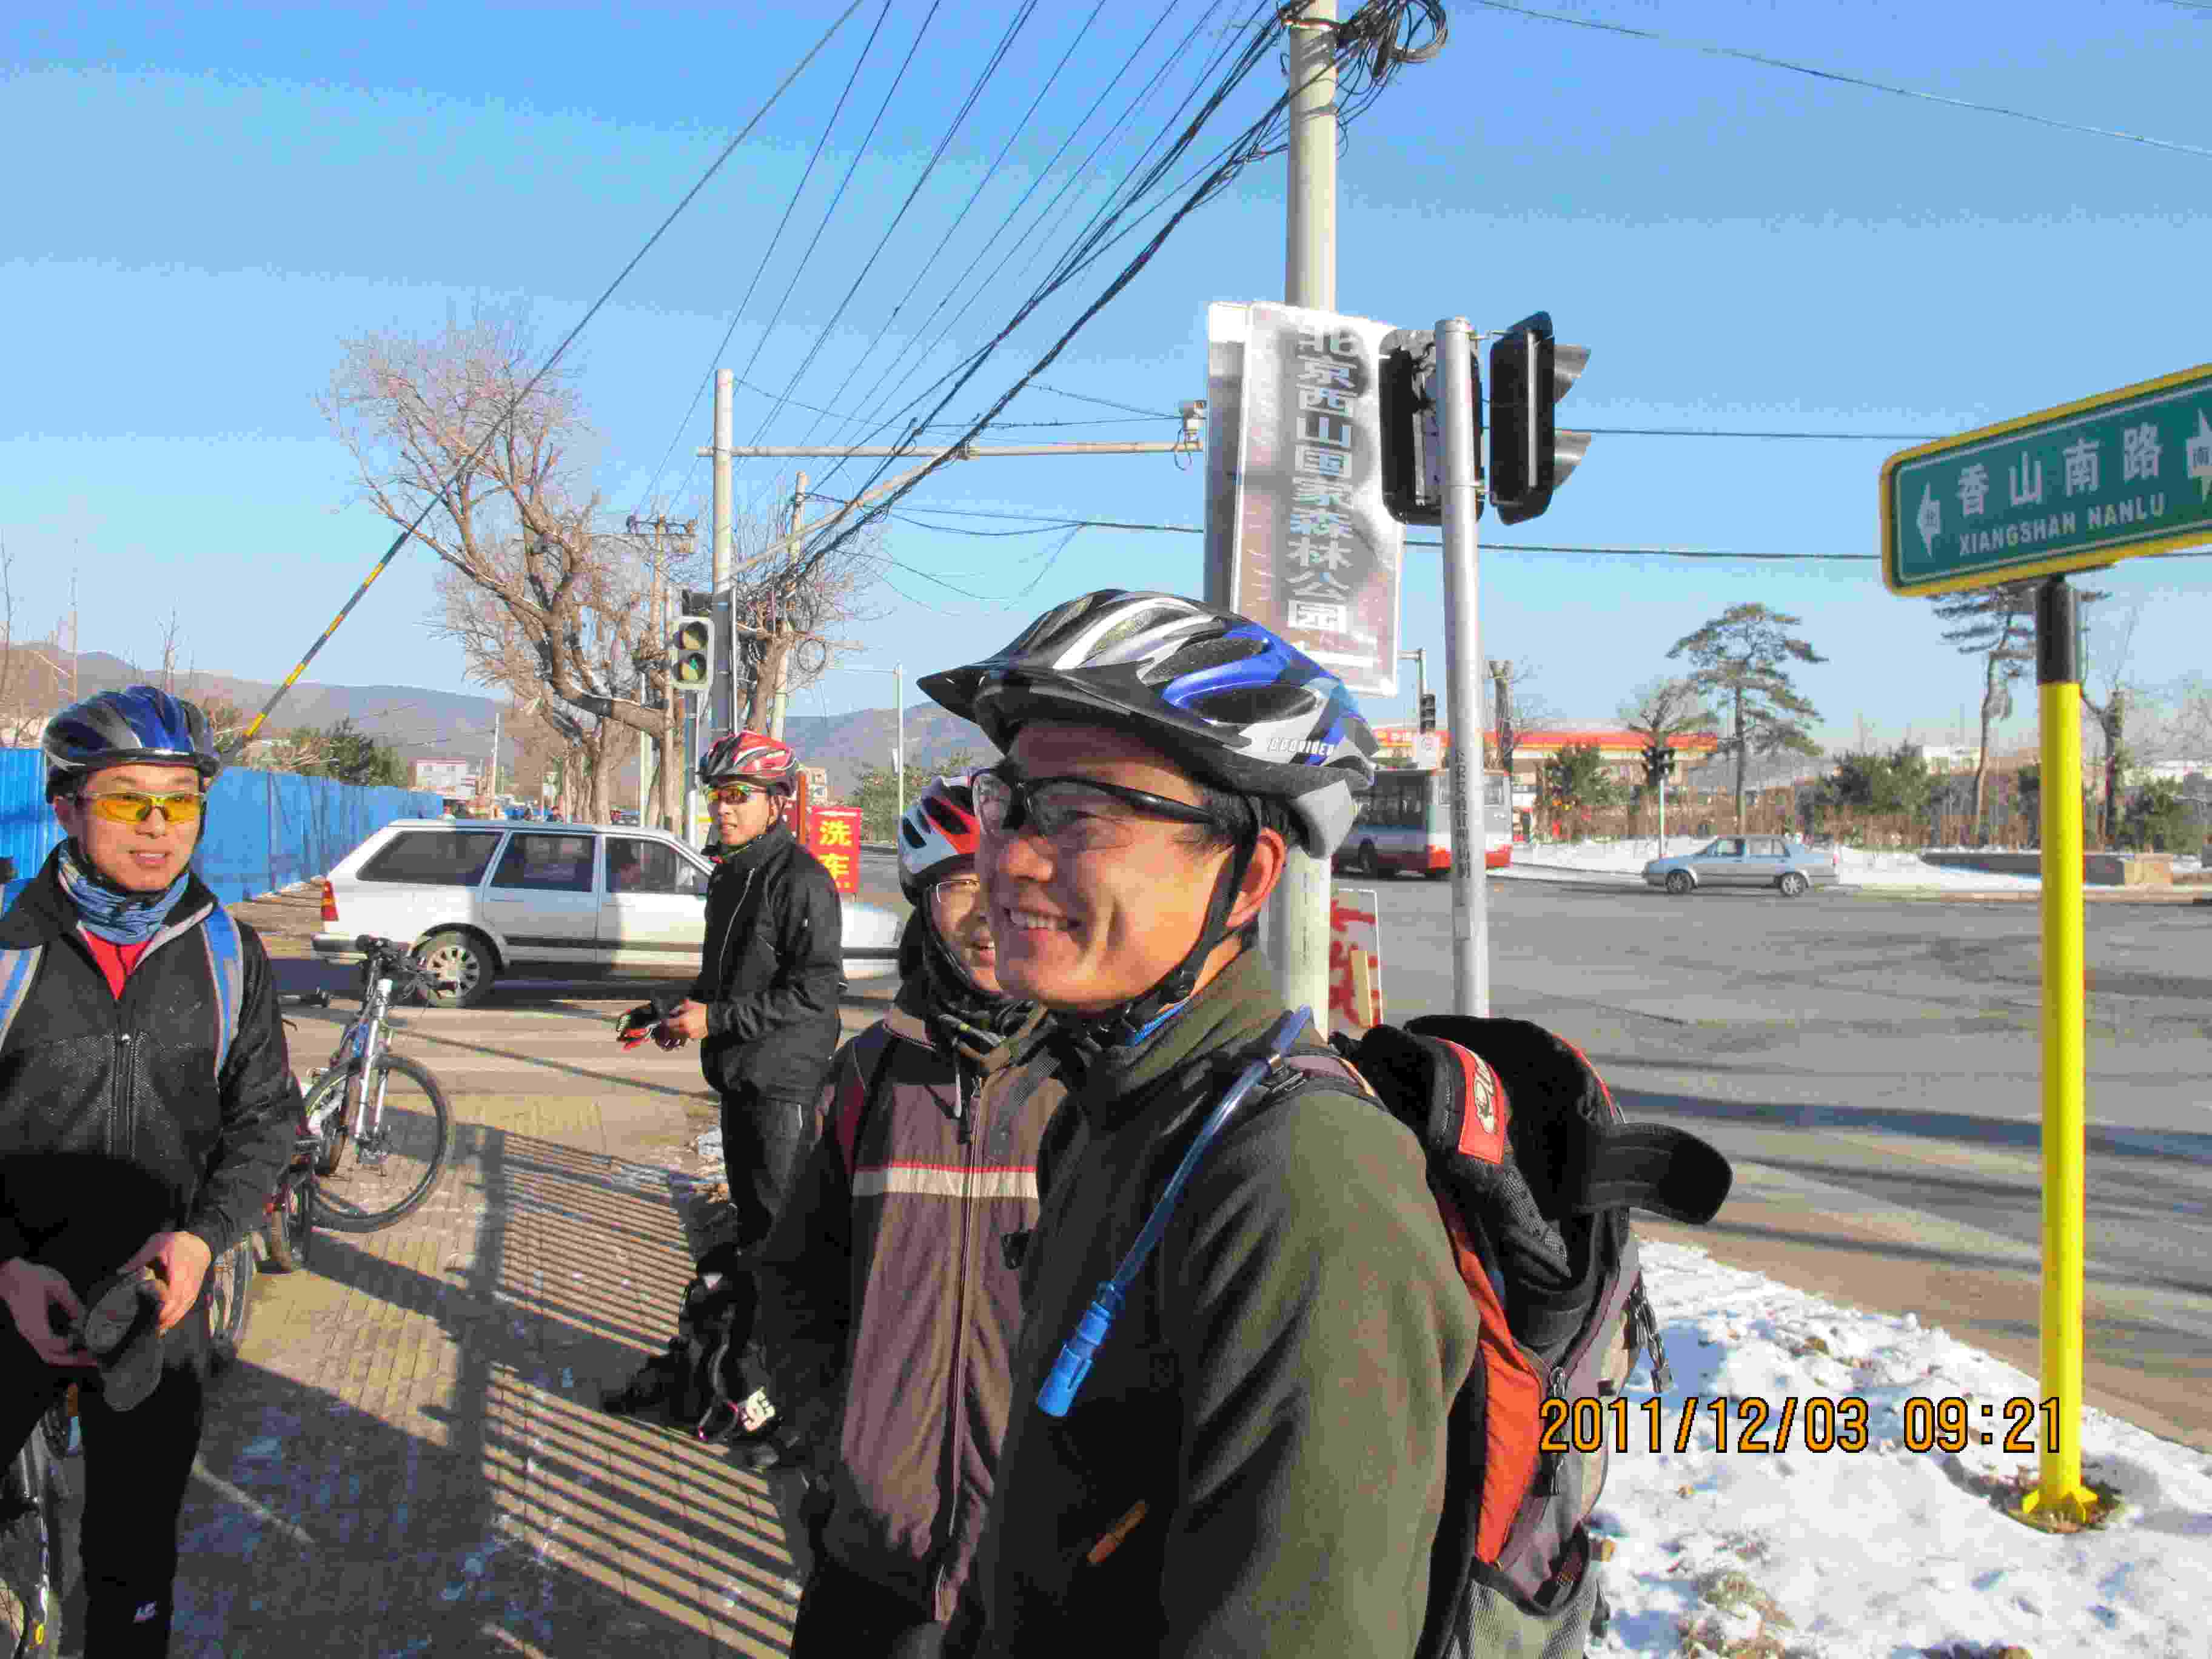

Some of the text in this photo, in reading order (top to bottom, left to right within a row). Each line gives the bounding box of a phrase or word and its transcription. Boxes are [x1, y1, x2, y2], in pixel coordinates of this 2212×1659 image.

[1956, 422, 2162, 518] 香山南路
[1959, 511, 2077, 557] XIANGSHAN
[2088, 492, 2165, 529] NANLU
[819, 820, 853, 880] 洗车
